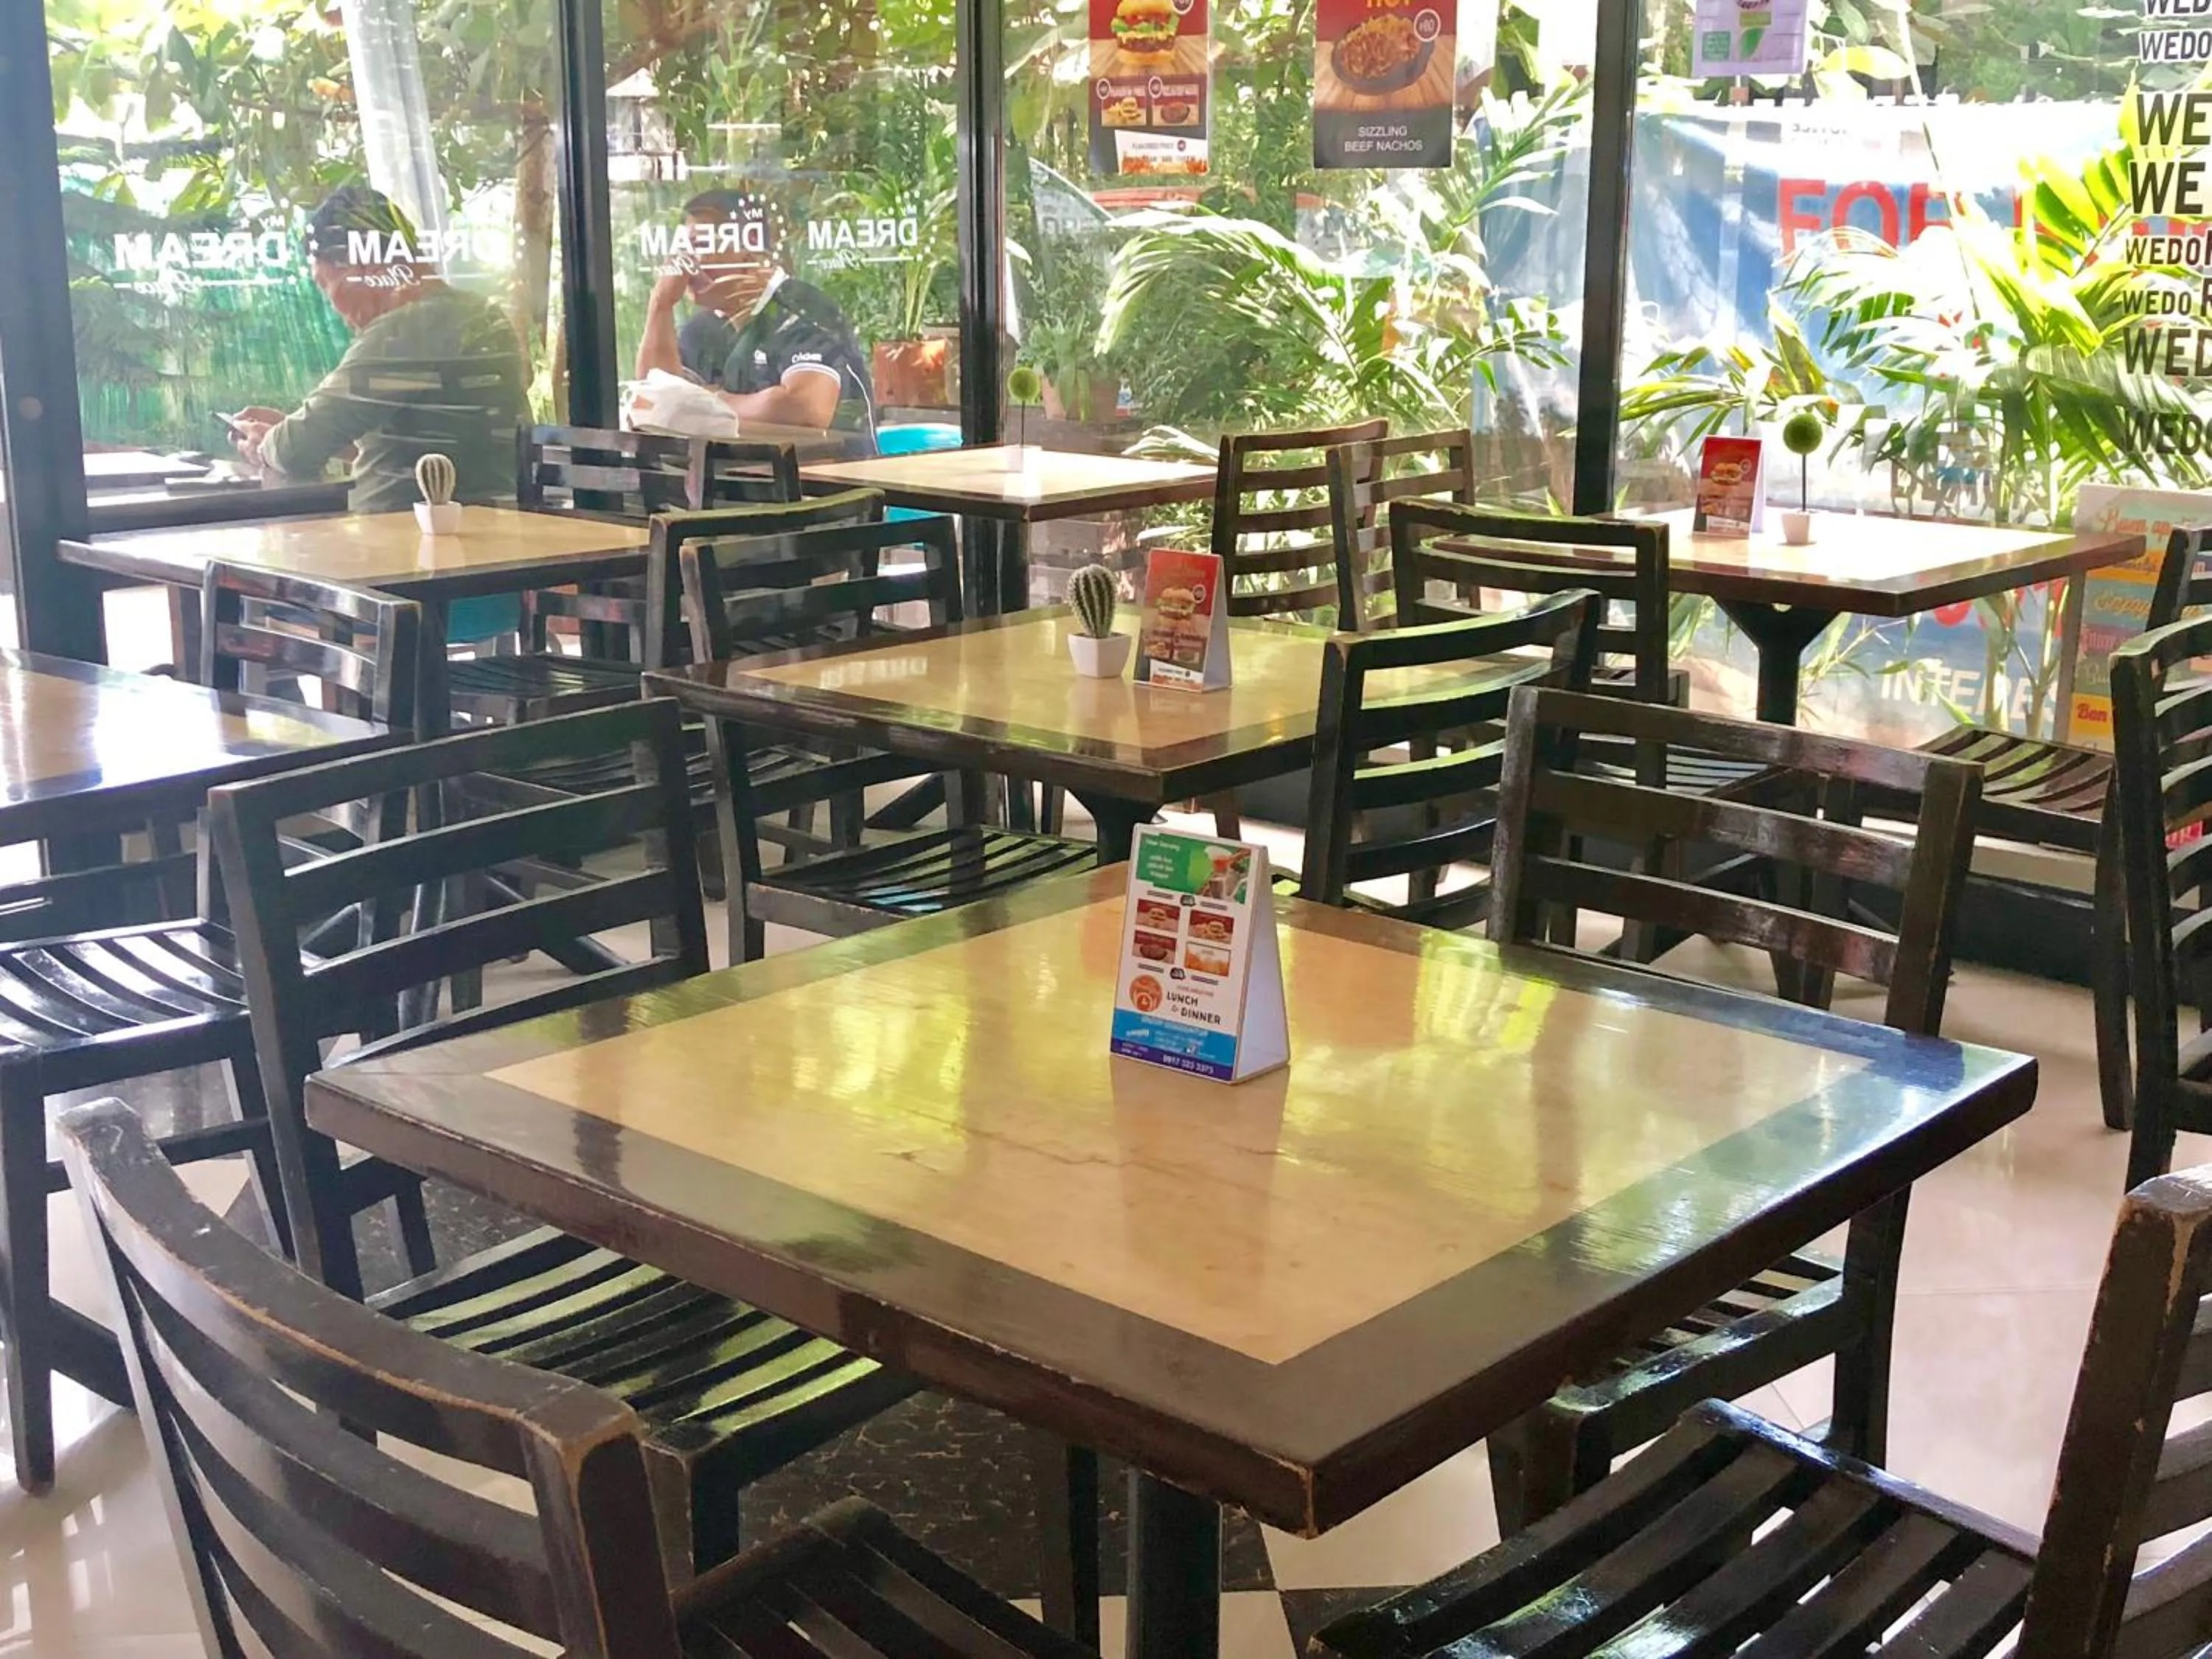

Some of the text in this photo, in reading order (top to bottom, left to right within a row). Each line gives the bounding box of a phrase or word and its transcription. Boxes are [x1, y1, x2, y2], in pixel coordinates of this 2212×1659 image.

[1357, 125, 1408, 138] SIZZLING
[1344, 139, 1423, 153] BEEF NACHOS
[2129, 161, 2207, 215] WE
[1166, 990, 1198, 1007] LUNCH
[1181, 1006, 1221, 1025] DINNER
